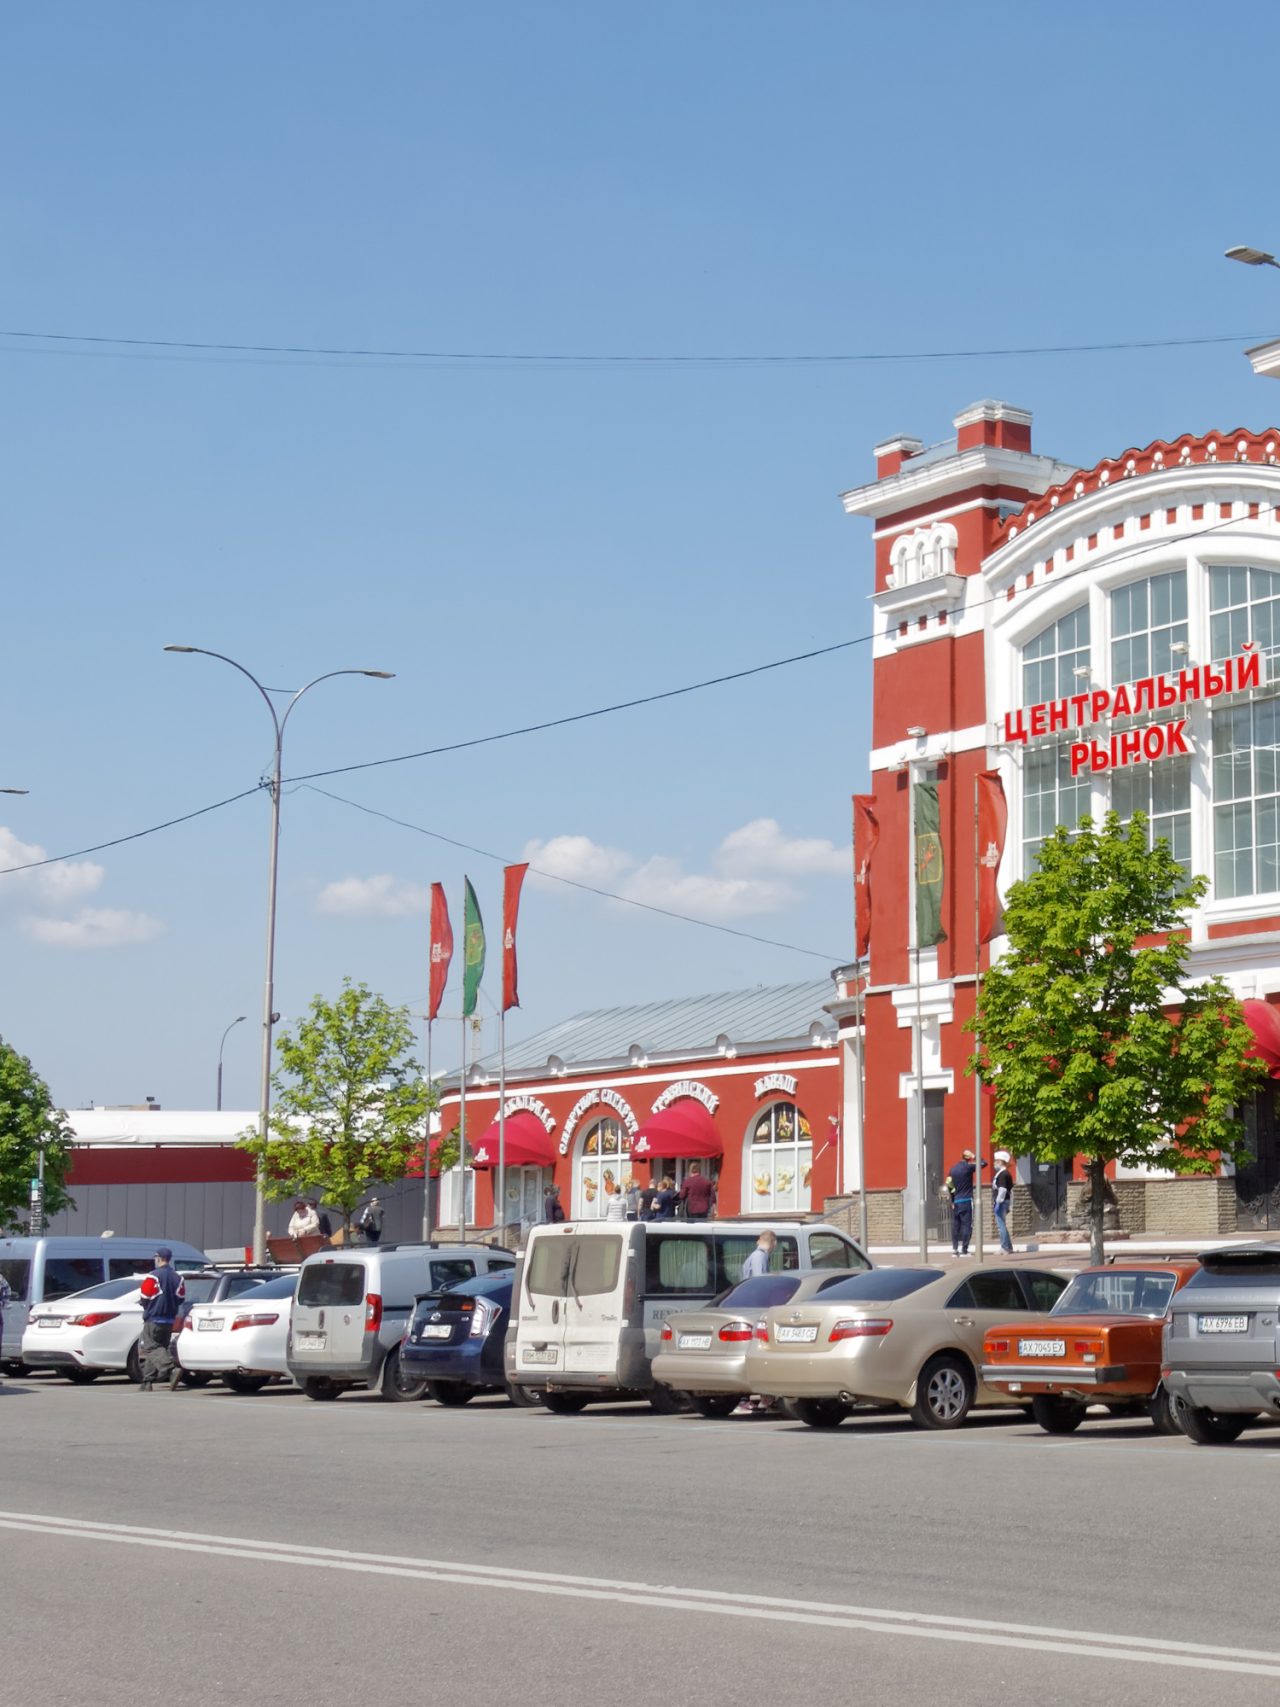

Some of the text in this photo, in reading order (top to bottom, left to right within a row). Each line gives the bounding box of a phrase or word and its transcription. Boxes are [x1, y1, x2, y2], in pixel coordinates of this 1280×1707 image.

[1004, 641, 1261, 744] ЦЕНТРАЛЬНЫЙ
[1071, 720, 1188, 777] РЫНОК
[1203, 1316, 1214, 1328] AX
[1023, 1343, 1063, 1353] AX 7045 EX
